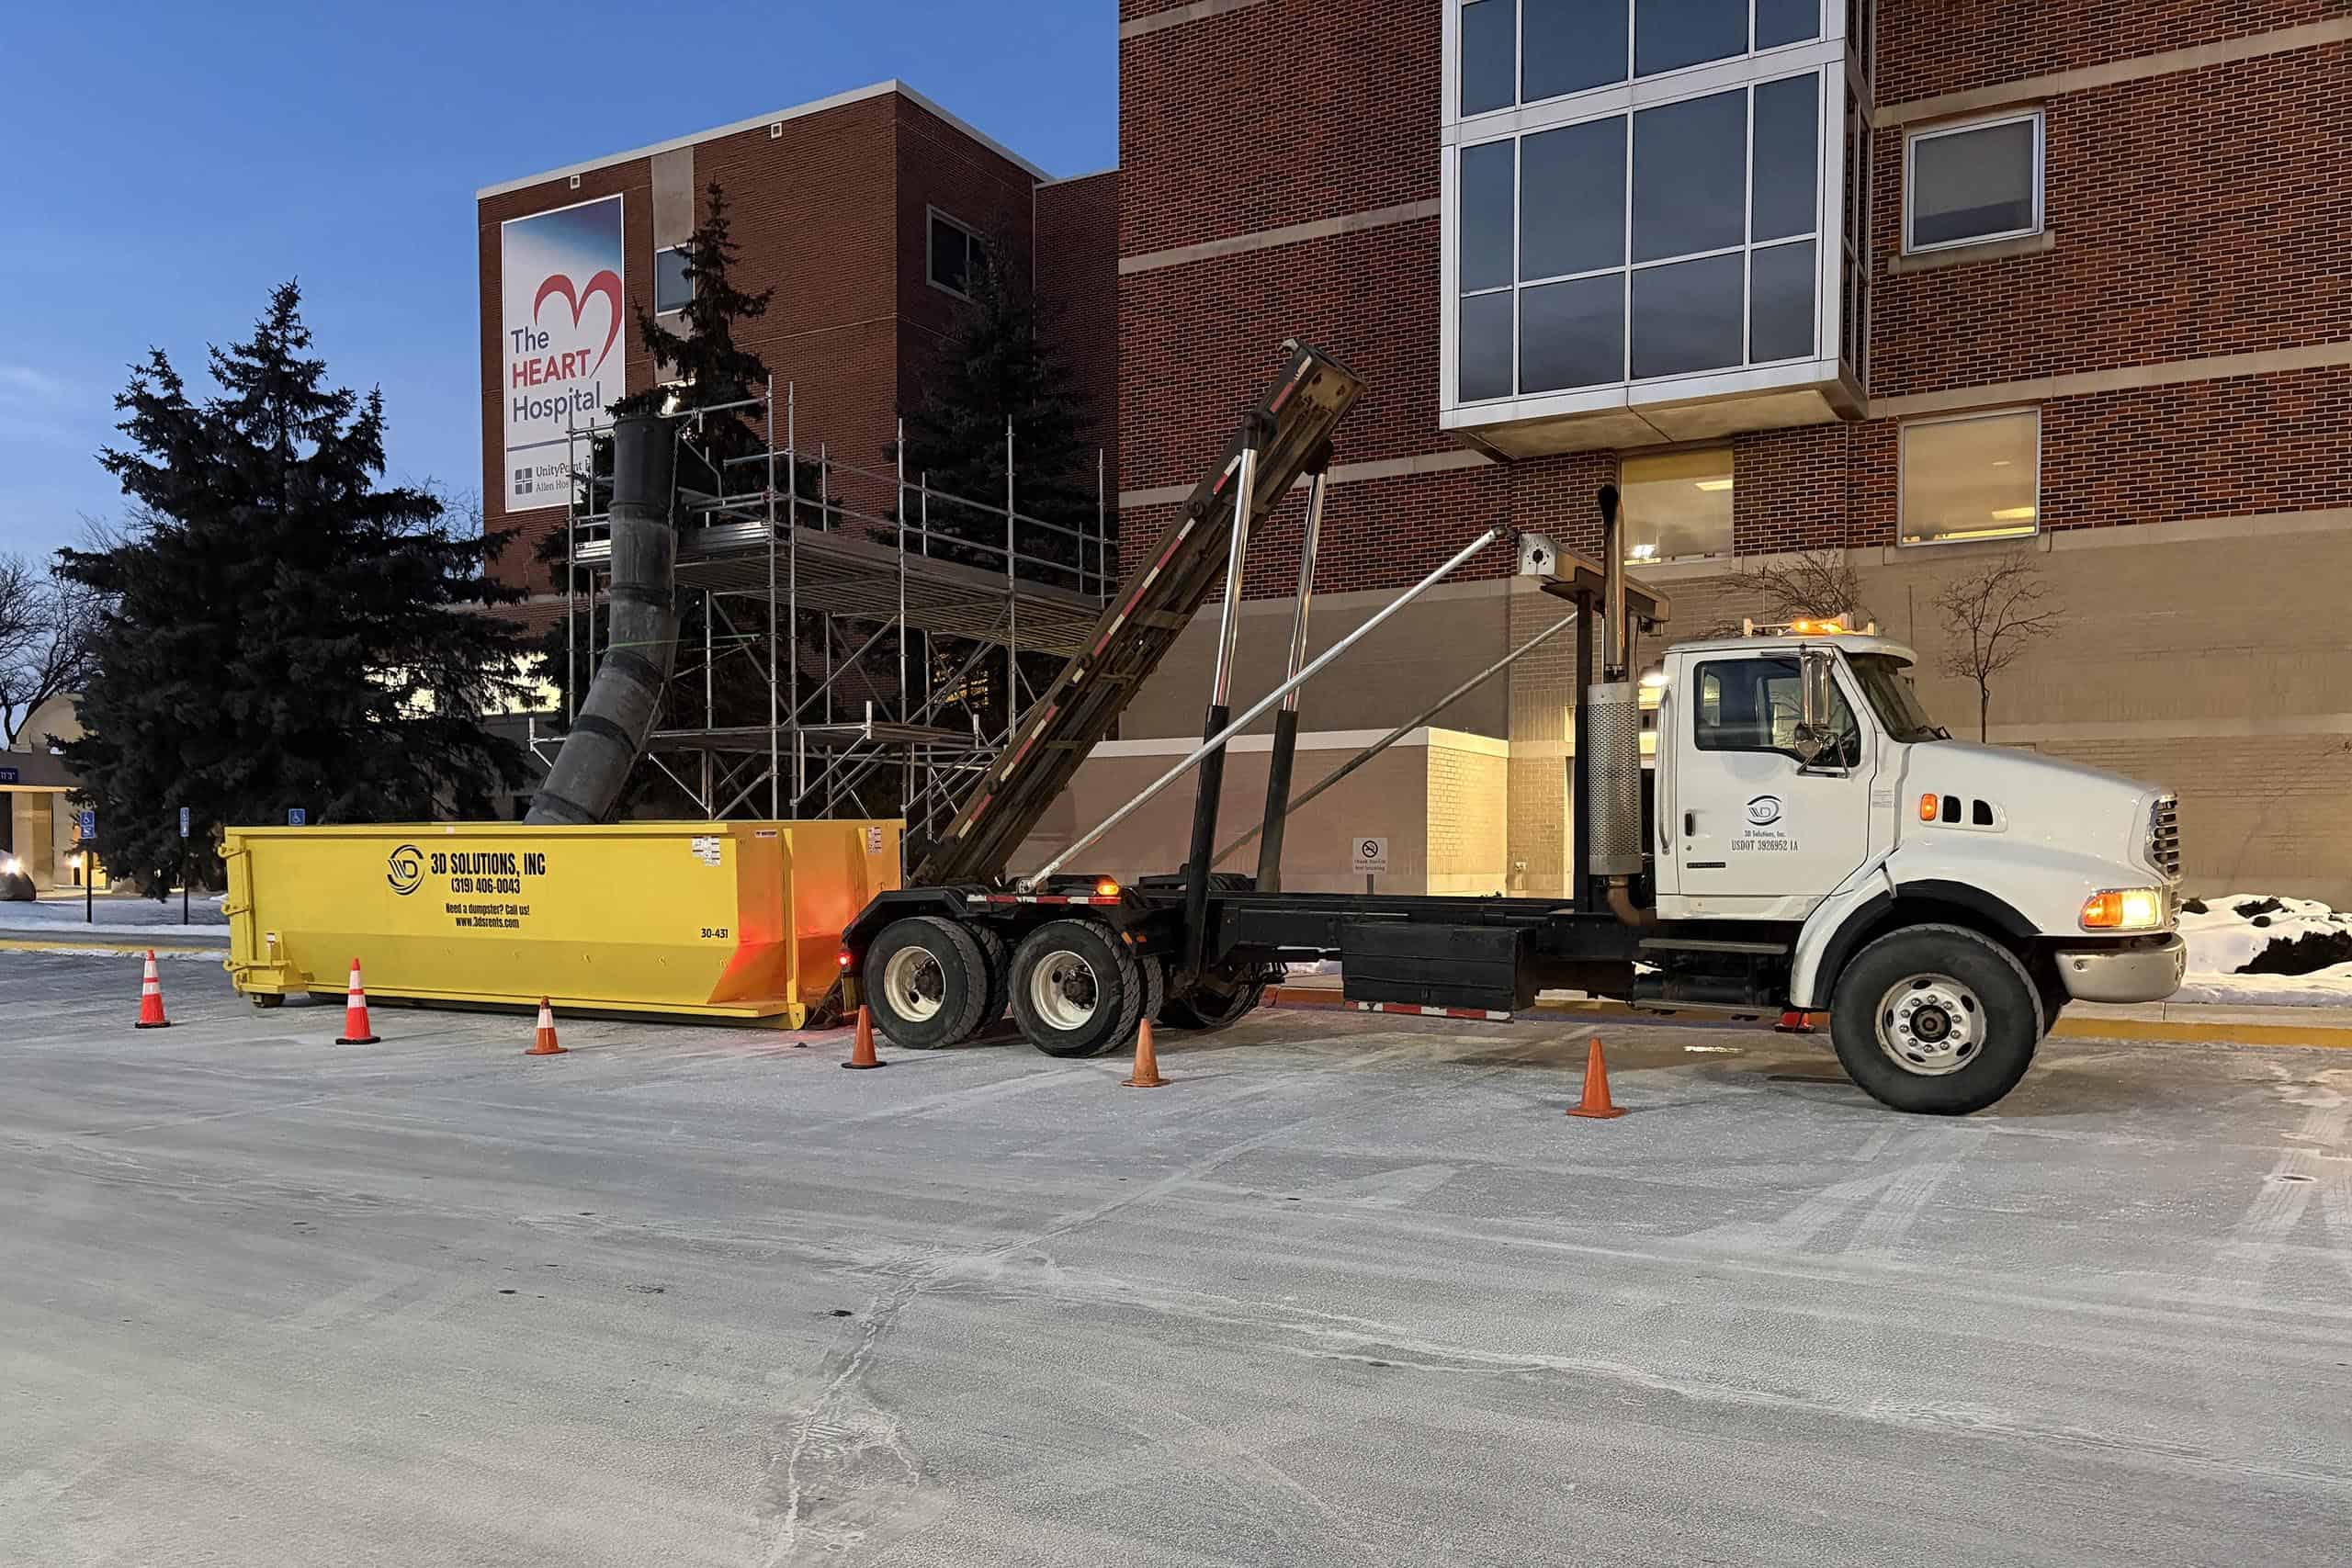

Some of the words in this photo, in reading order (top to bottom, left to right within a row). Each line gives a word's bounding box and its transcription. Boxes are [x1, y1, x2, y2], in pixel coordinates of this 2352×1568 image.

[511, 326, 549, 354] The
[513, 349, 591, 389] HEART
[514, 380, 600, 423] Hospital
[536, 462, 582, 477] UnityPont
[536, 480, 554, 492] Allen
[1732, 840, 1755, 851] USDOT
[1758, 840, 1788, 851] 3926952
[1790, 840, 1798, 851] IA
[431, 852, 447, 874] 3D
[450, 852, 520, 877] SOLUTIONS,
[524, 852, 546, 875] INC
[451, 878, 473, 893] (319)
[476, 878, 521, 894] 406-0043
[446, 903, 461, 914] Need
[463, 905, 468, 914] a
[469, 904, 503, 916] dumpster?
[505, 904, 518, 915] Call
[519, 905, 530, 916] us!
[701, 928, 729, 939] 30-431
